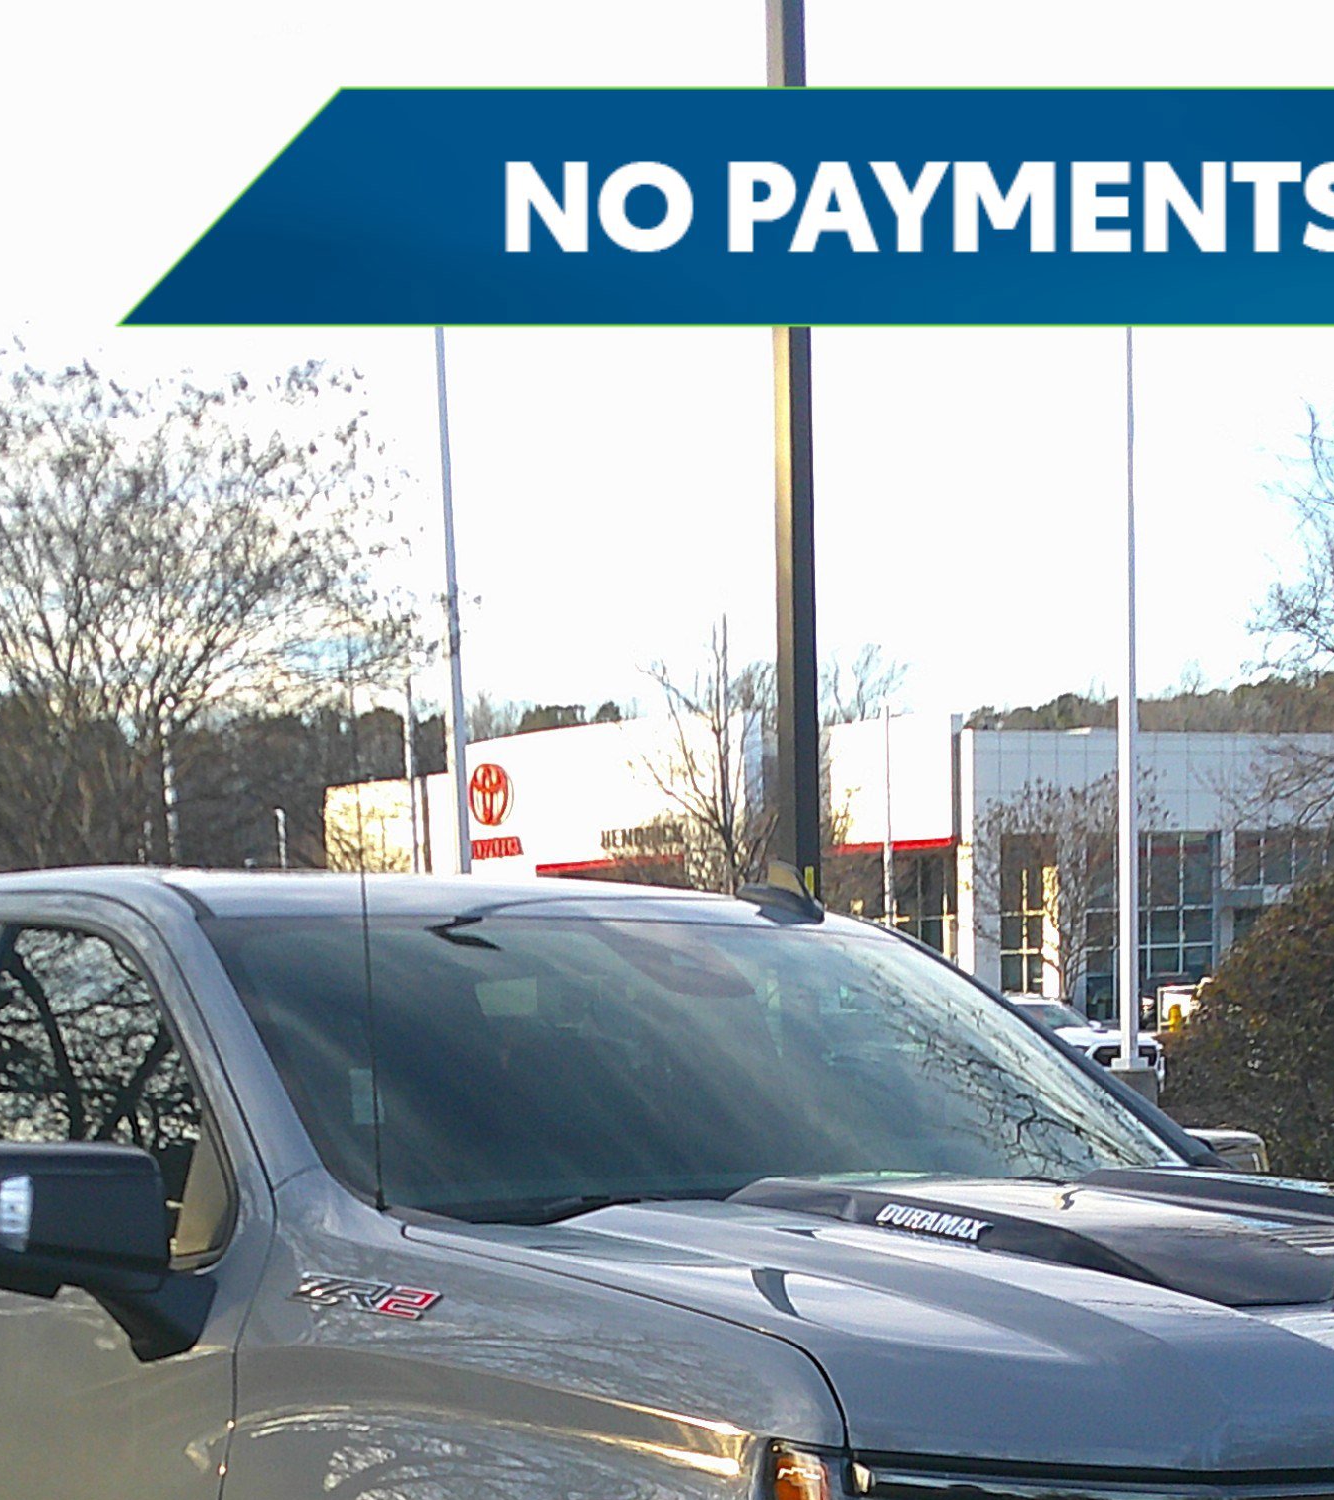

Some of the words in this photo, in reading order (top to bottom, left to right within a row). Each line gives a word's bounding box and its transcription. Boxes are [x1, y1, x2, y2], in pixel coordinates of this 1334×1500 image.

[471, 836, 524, 860] OYOTA
[875, 1203, 994, 1241] DURAMAX
[292, 1271, 443, 1320] ZR2
